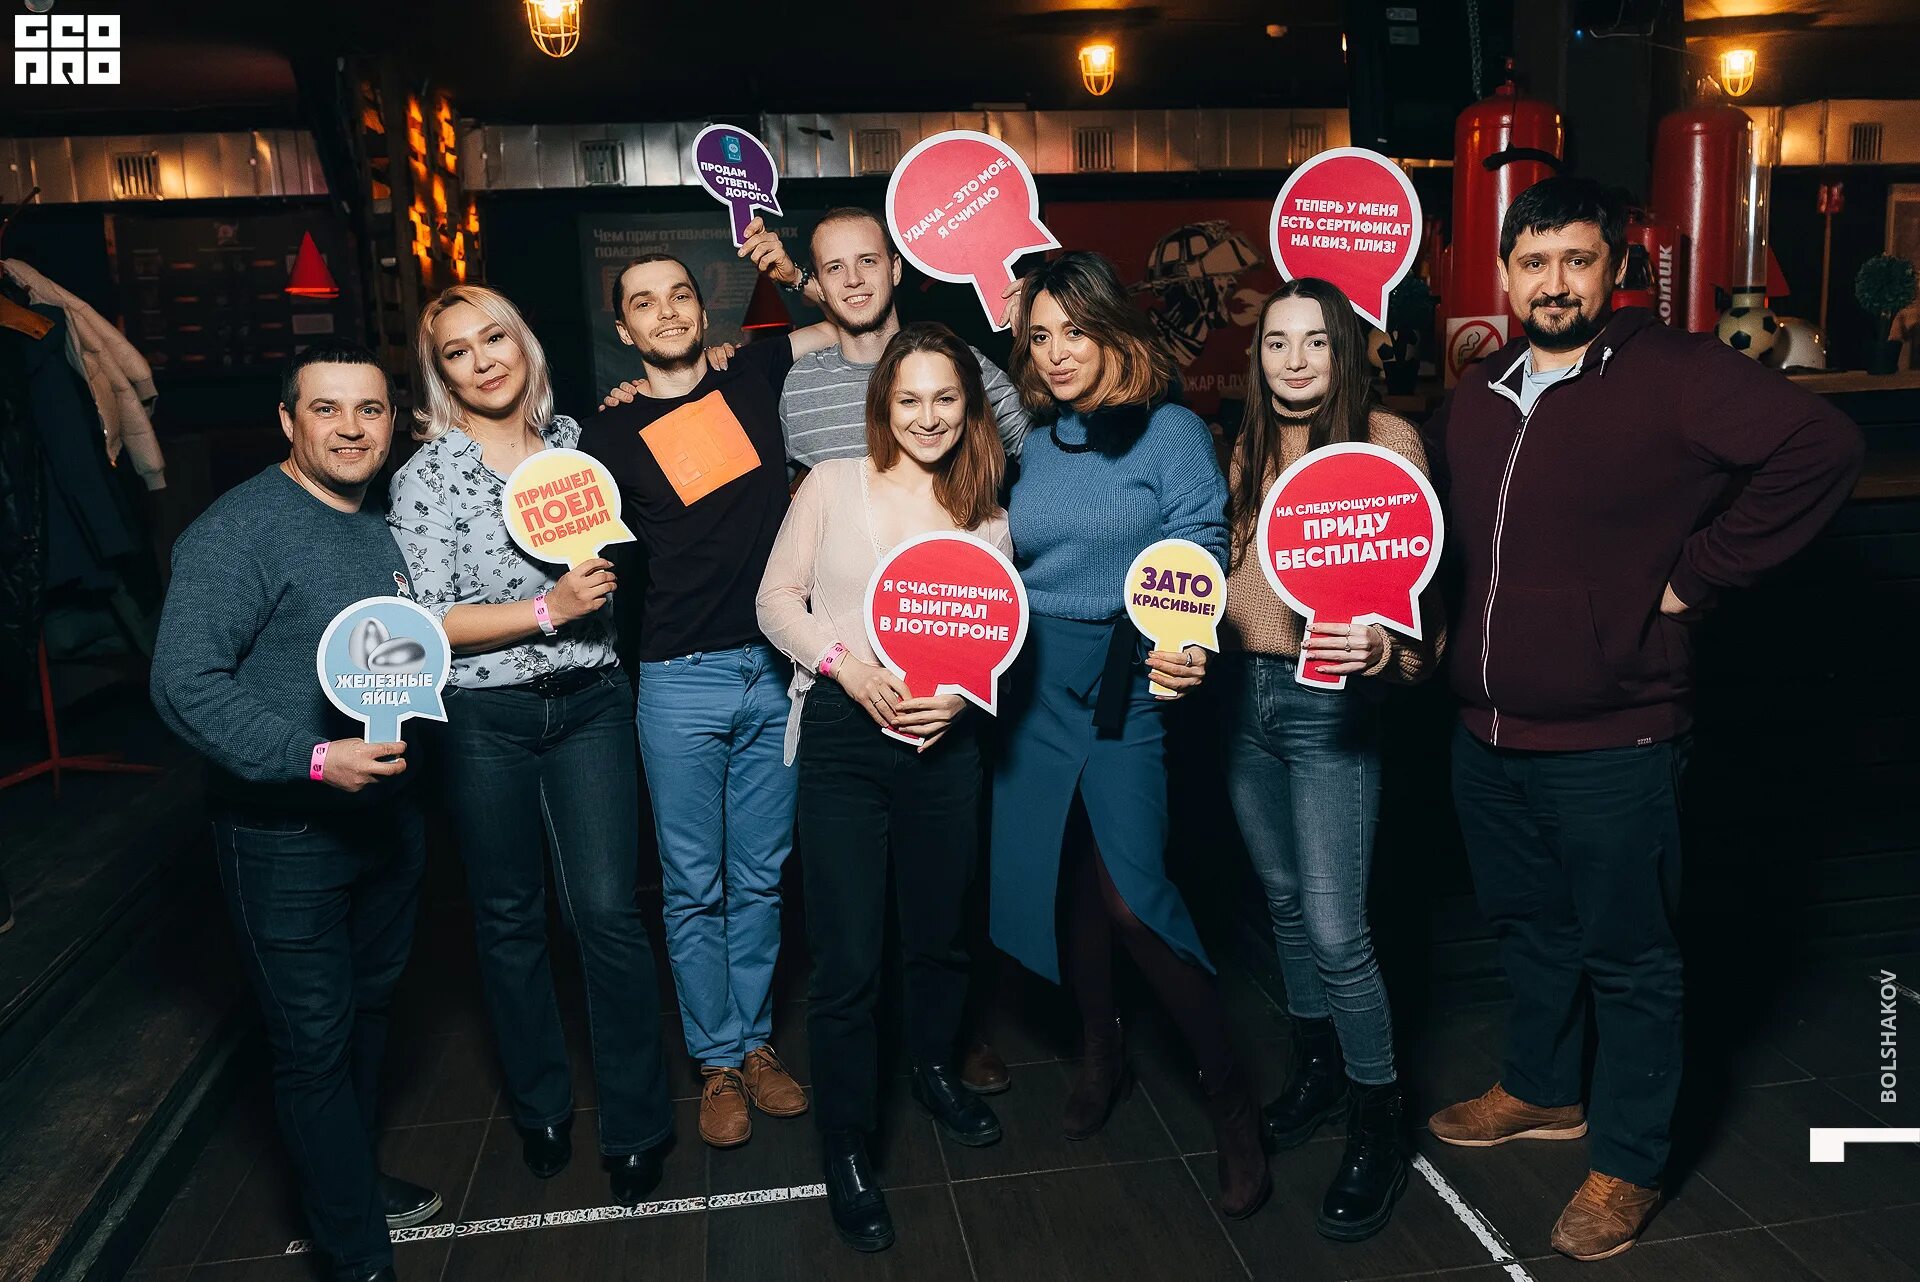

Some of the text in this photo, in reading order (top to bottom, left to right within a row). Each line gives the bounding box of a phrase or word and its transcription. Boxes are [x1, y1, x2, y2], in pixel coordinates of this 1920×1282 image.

[700, 161, 746, 178] ПРОДАМ
[715, 175, 761, 192] ОТВЕТЫ.
[725, 187, 773, 203] ДОРОГО.
[902, 207, 945, 243] УДАЧА
[952, 179, 980, 204] ЭТО
[977, 157, 1012, 185] МОЕ,
[1295, 199, 1399, 217] ТЕПЕРЬ У МЕНЯ
[936, 186, 1000, 239] Я СЧИТАЮ
[626, 227, 732, 244] приготовлени
[1280, 215, 1411, 236] ЕСТЬ СЕРТИФИКАТ
[1290, 234, 1396, 254] НА КВИЗ, ПЛИЗ!
[514, 468, 596, 509] ПРИШЕЛ
[521, 485, 605, 532] ПОЕЛ
[1276, 492, 1418, 517] НА СЛЕДУЮЩУЮ ИГРУ
[530, 509, 611, 547] ПОБЕДИЛ
[1303, 511, 1391, 541] ПРИДУ
[1275, 535, 1430, 571] БЕСПЛАТНО
[883, 579, 1014, 604] Я СЧАСТЛИВЧИК,
[1140, 566, 1213, 597] ЗАТО
[899, 597, 988, 619] ВЫИГРАЛ
[1132, 592, 1216, 616] КРАСИВЫЕ!
[879, 616, 1009, 642] В ЛОТОТРОНЕ
[335, 672, 433, 688] ЖЕЛЕЗНЫЕ
[360, 688, 411, 706] ЯЙЦА
